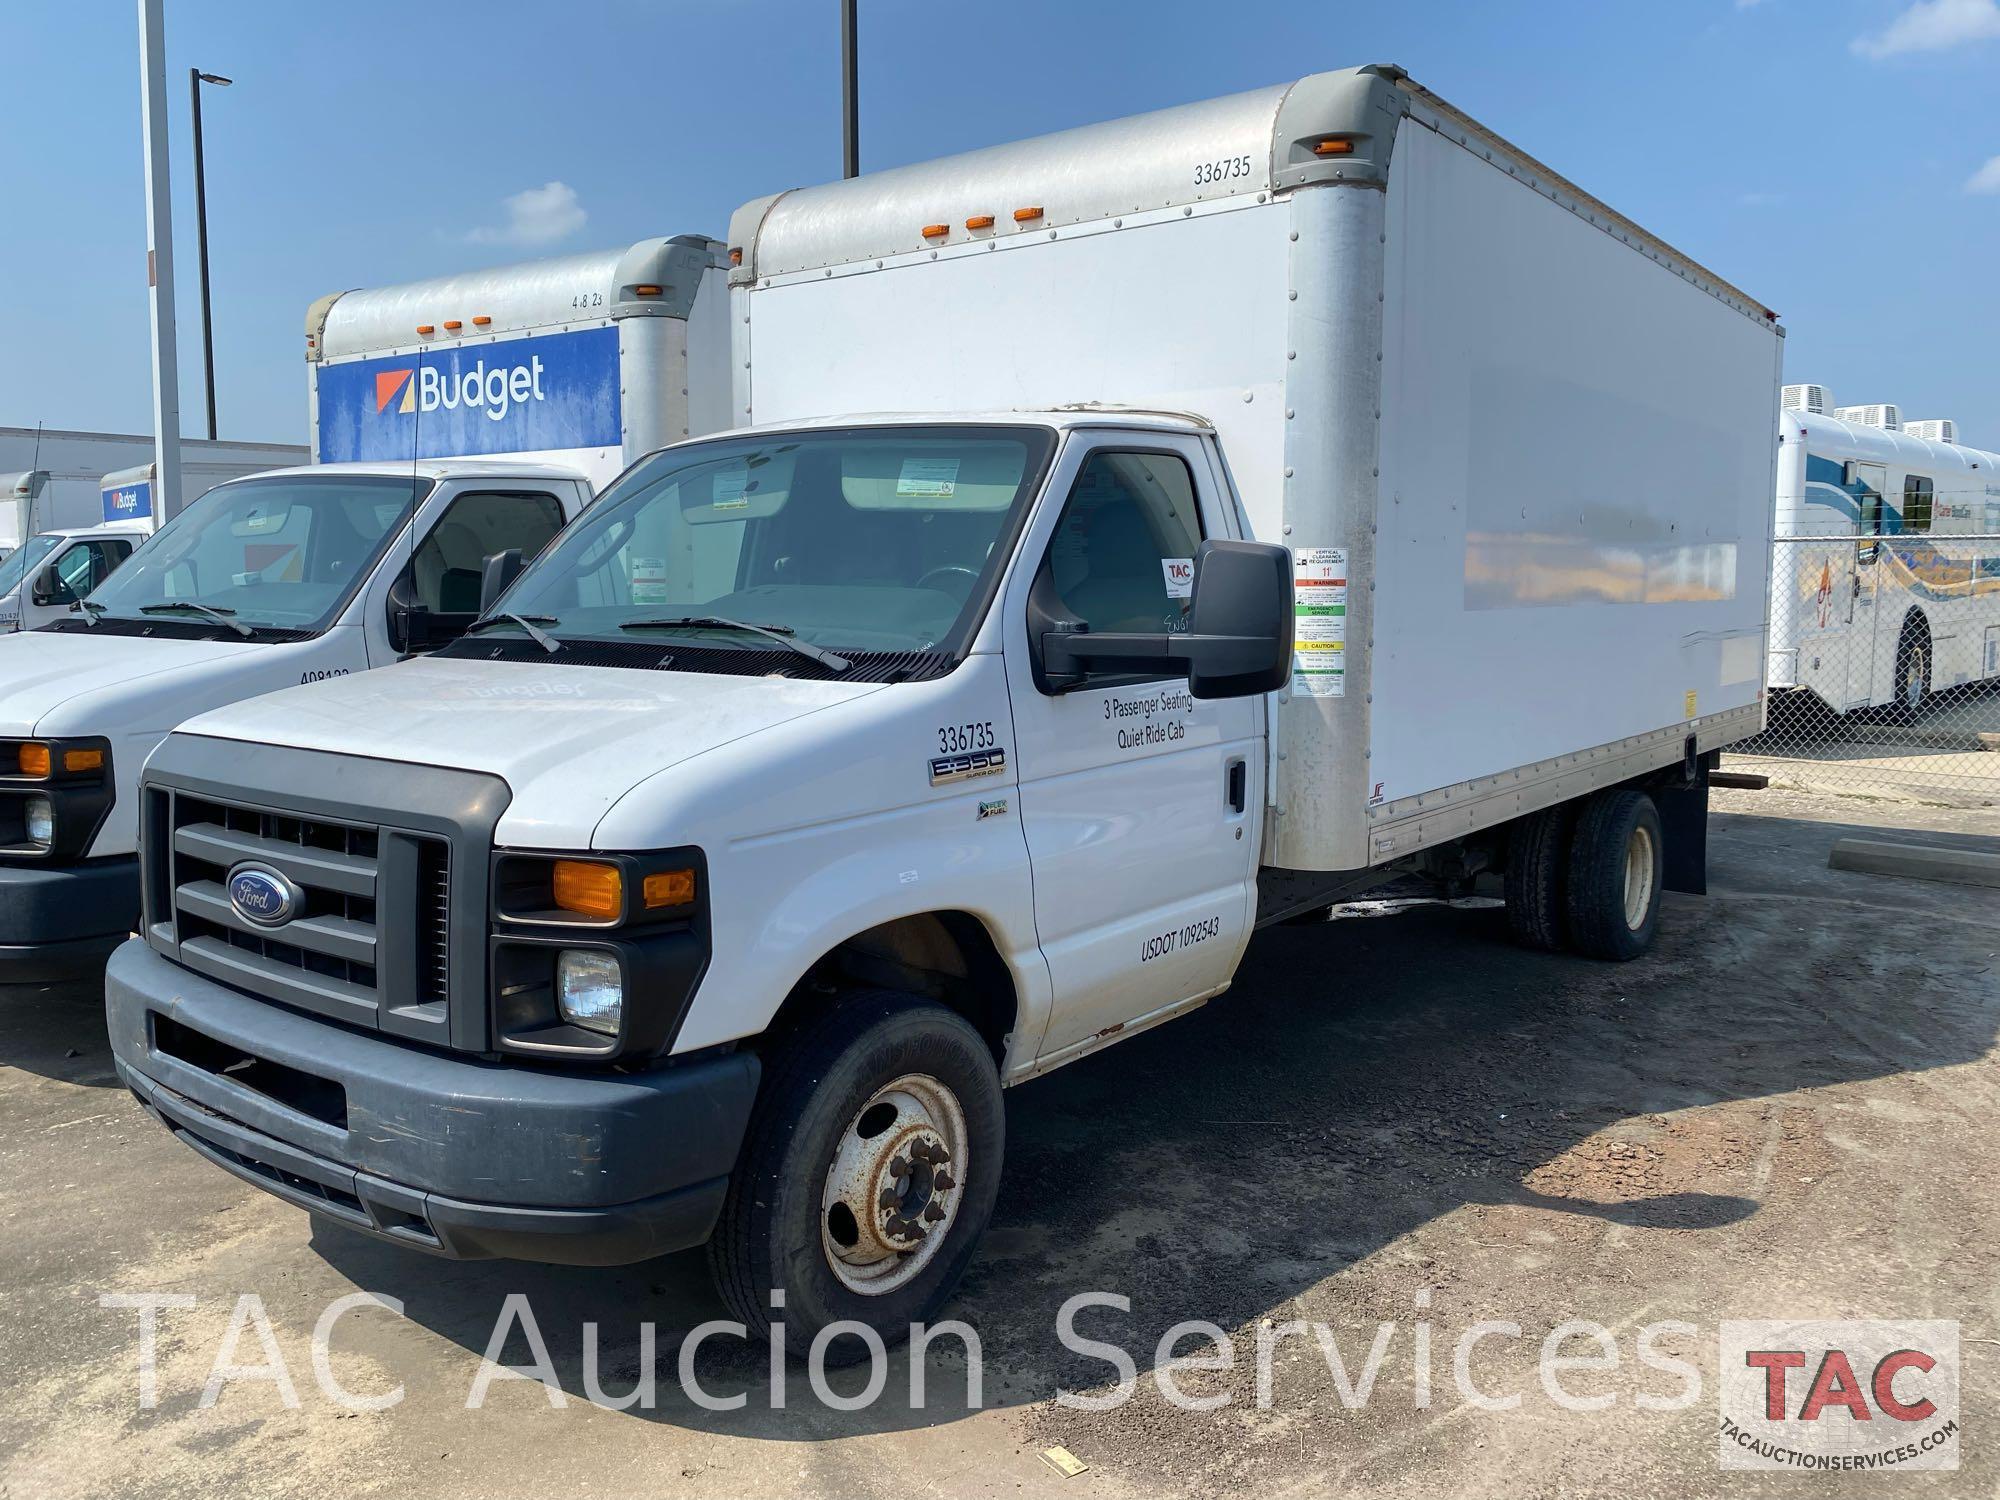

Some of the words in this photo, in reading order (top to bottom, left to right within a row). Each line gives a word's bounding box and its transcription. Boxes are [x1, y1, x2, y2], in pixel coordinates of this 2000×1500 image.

[1194, 155, 1250, 185] 336735
[420, 355, 545, 421] Budget
[117, 490, 138, 513] Budget
[1168, 564, 1190, 578] TAC
[1104, 699, 1111, 720] 3
[1112, 698, 1159, 720] Passenger
[1160, 689, 1193, 713] Seating
[938, 722, 994, 753] 336735
[1117, 728, 1144, 749] Quiet
[1145, 722, 1166, 745] Ride
[1167, 719, 1185, 741] Cab
[966, 770, 987, 779] SUPER
[987, 767, 1005, 776] DUTY
[989, 800, 1007, 809] FLEX
[989, 808, 1007, 816] FUEL
[238, 879, 269, 909] Ford
[1141, 930, 1177, 962] USDOT
[1178, 916, 1219, 948] 1092543
